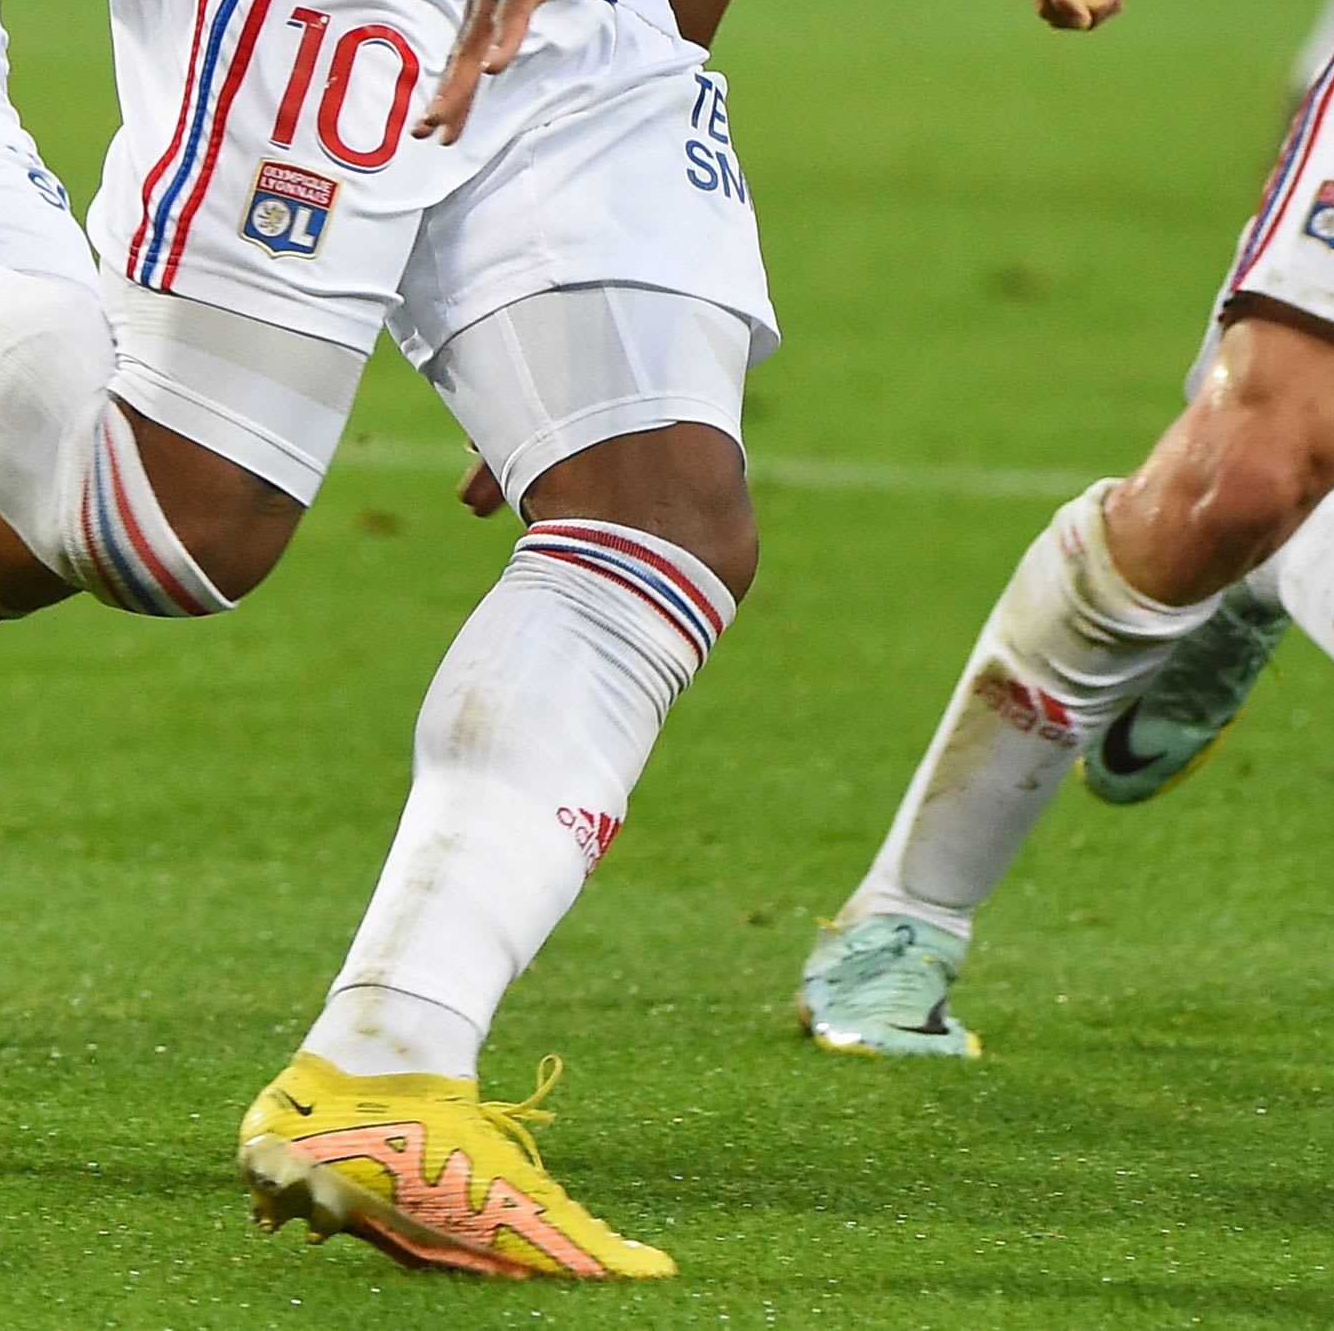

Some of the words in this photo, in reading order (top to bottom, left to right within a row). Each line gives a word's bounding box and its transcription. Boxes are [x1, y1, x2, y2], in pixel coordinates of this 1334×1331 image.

[270, 6, 420, 174] 10
[691, 72, 729, 145] TE
[259, 176, 330, 205] LYONNAIS
[685, 139, 747, 205] SN
